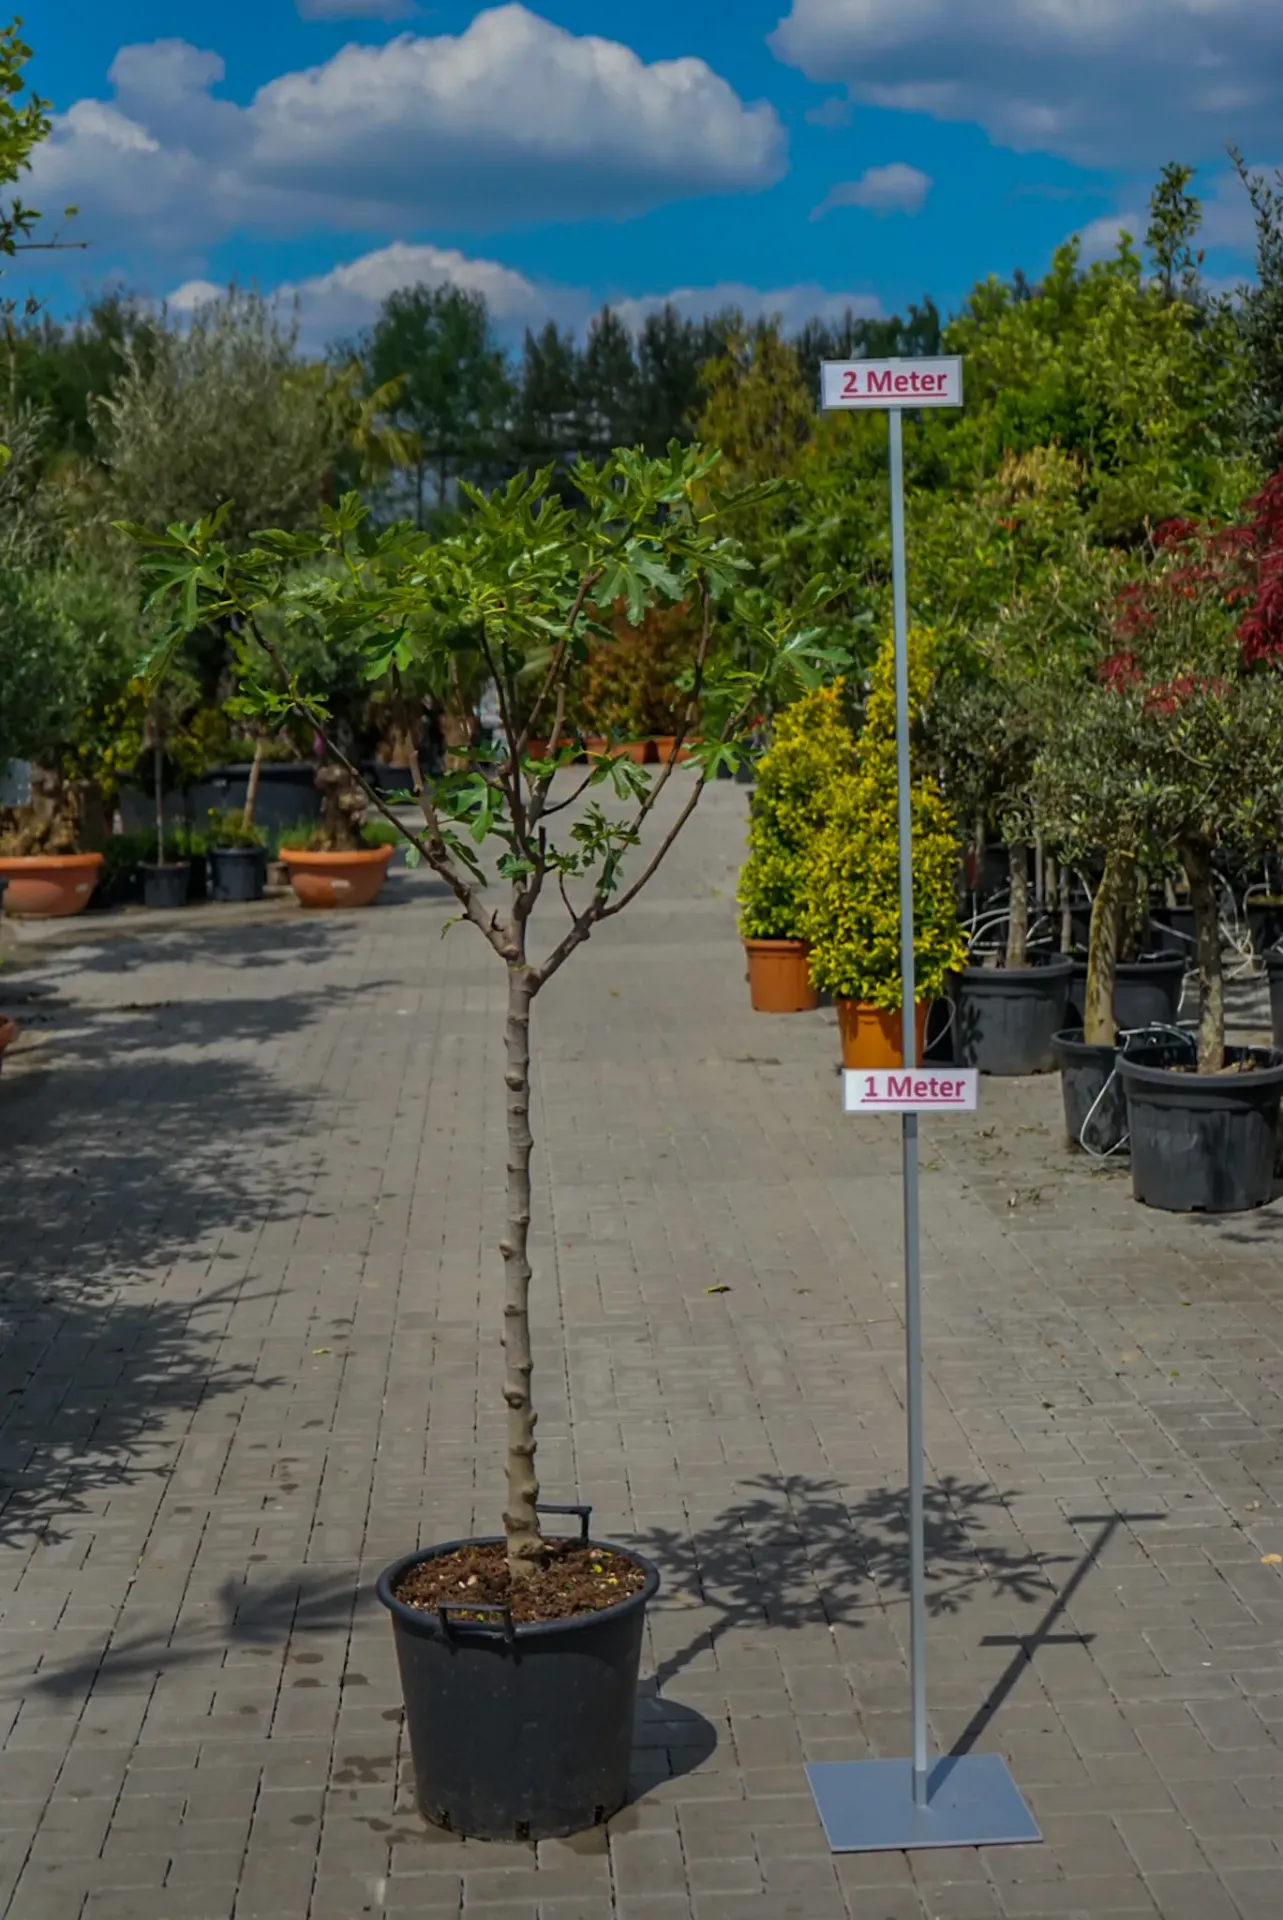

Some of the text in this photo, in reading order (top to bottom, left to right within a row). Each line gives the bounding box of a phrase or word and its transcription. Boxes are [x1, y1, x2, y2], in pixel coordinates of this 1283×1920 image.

[843, 369, 947, 393] 2 Meter
[865, 1076, 965, 1097] 1 Meter
